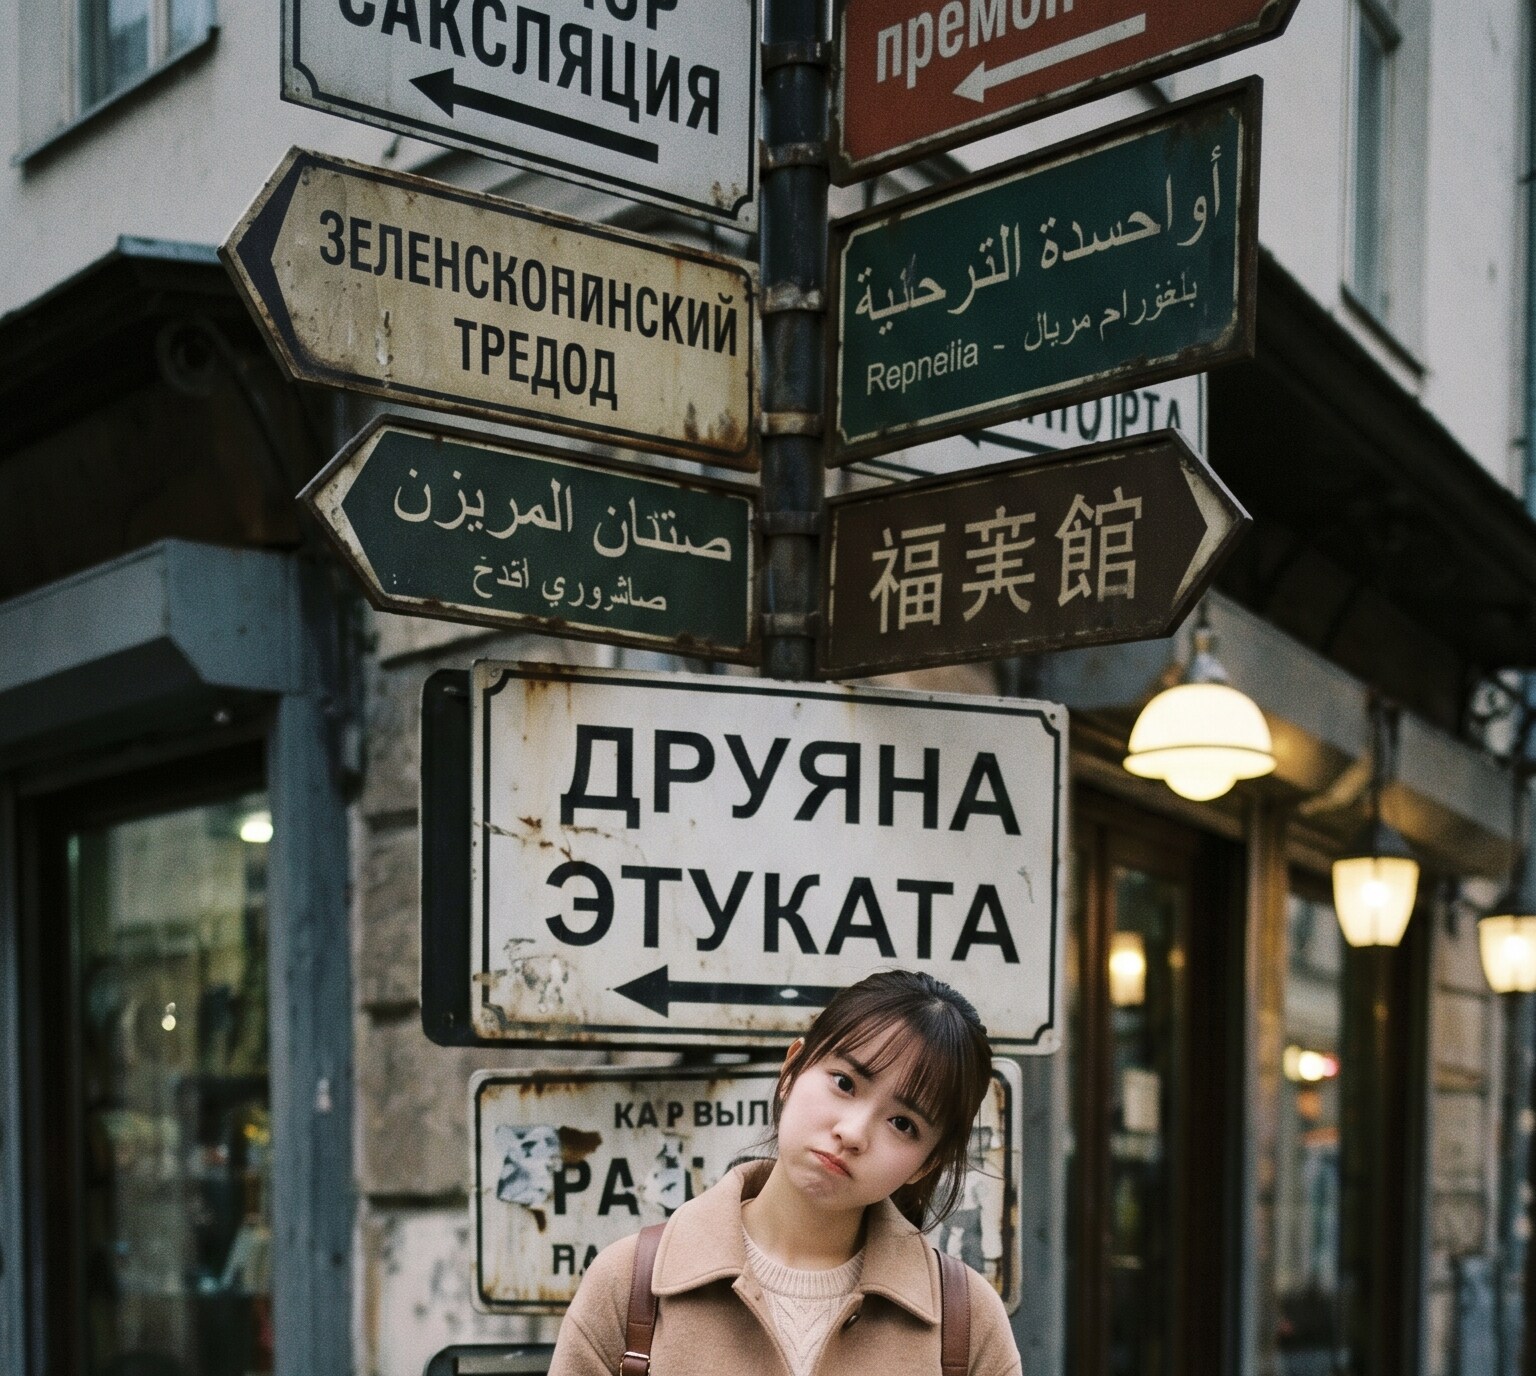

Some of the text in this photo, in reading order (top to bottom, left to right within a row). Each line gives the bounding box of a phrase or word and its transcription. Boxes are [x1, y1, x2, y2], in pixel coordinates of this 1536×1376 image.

[454, 318, 618, 410] ТРЕДОД
[560, 725, 1022, 836] ДРУЯНА
[545, 860, 1021, 964] ЭТУКАТА
